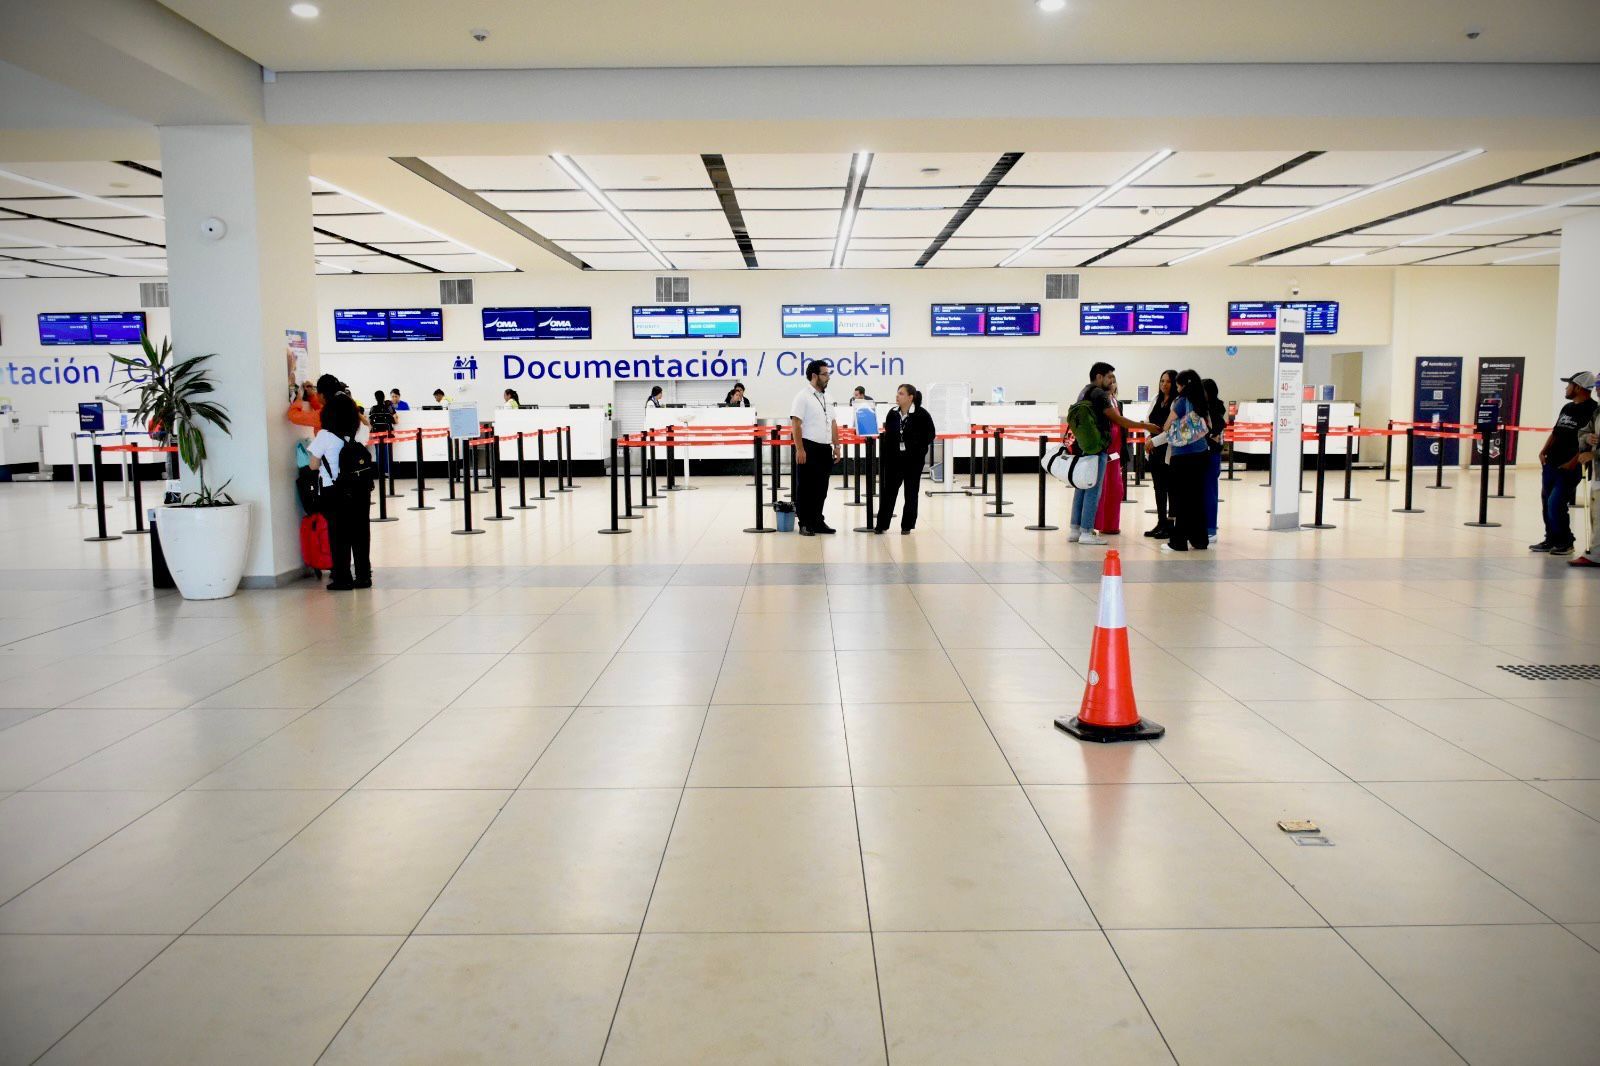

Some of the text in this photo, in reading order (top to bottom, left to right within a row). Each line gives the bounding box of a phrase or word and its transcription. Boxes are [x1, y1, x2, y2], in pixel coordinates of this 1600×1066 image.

[0, 357, 99, 385] tación
[503, 350, 748, 379] Documentación
[1281, 383, 1288, 391] 40
[1280, 418, 1287, 427] 30
